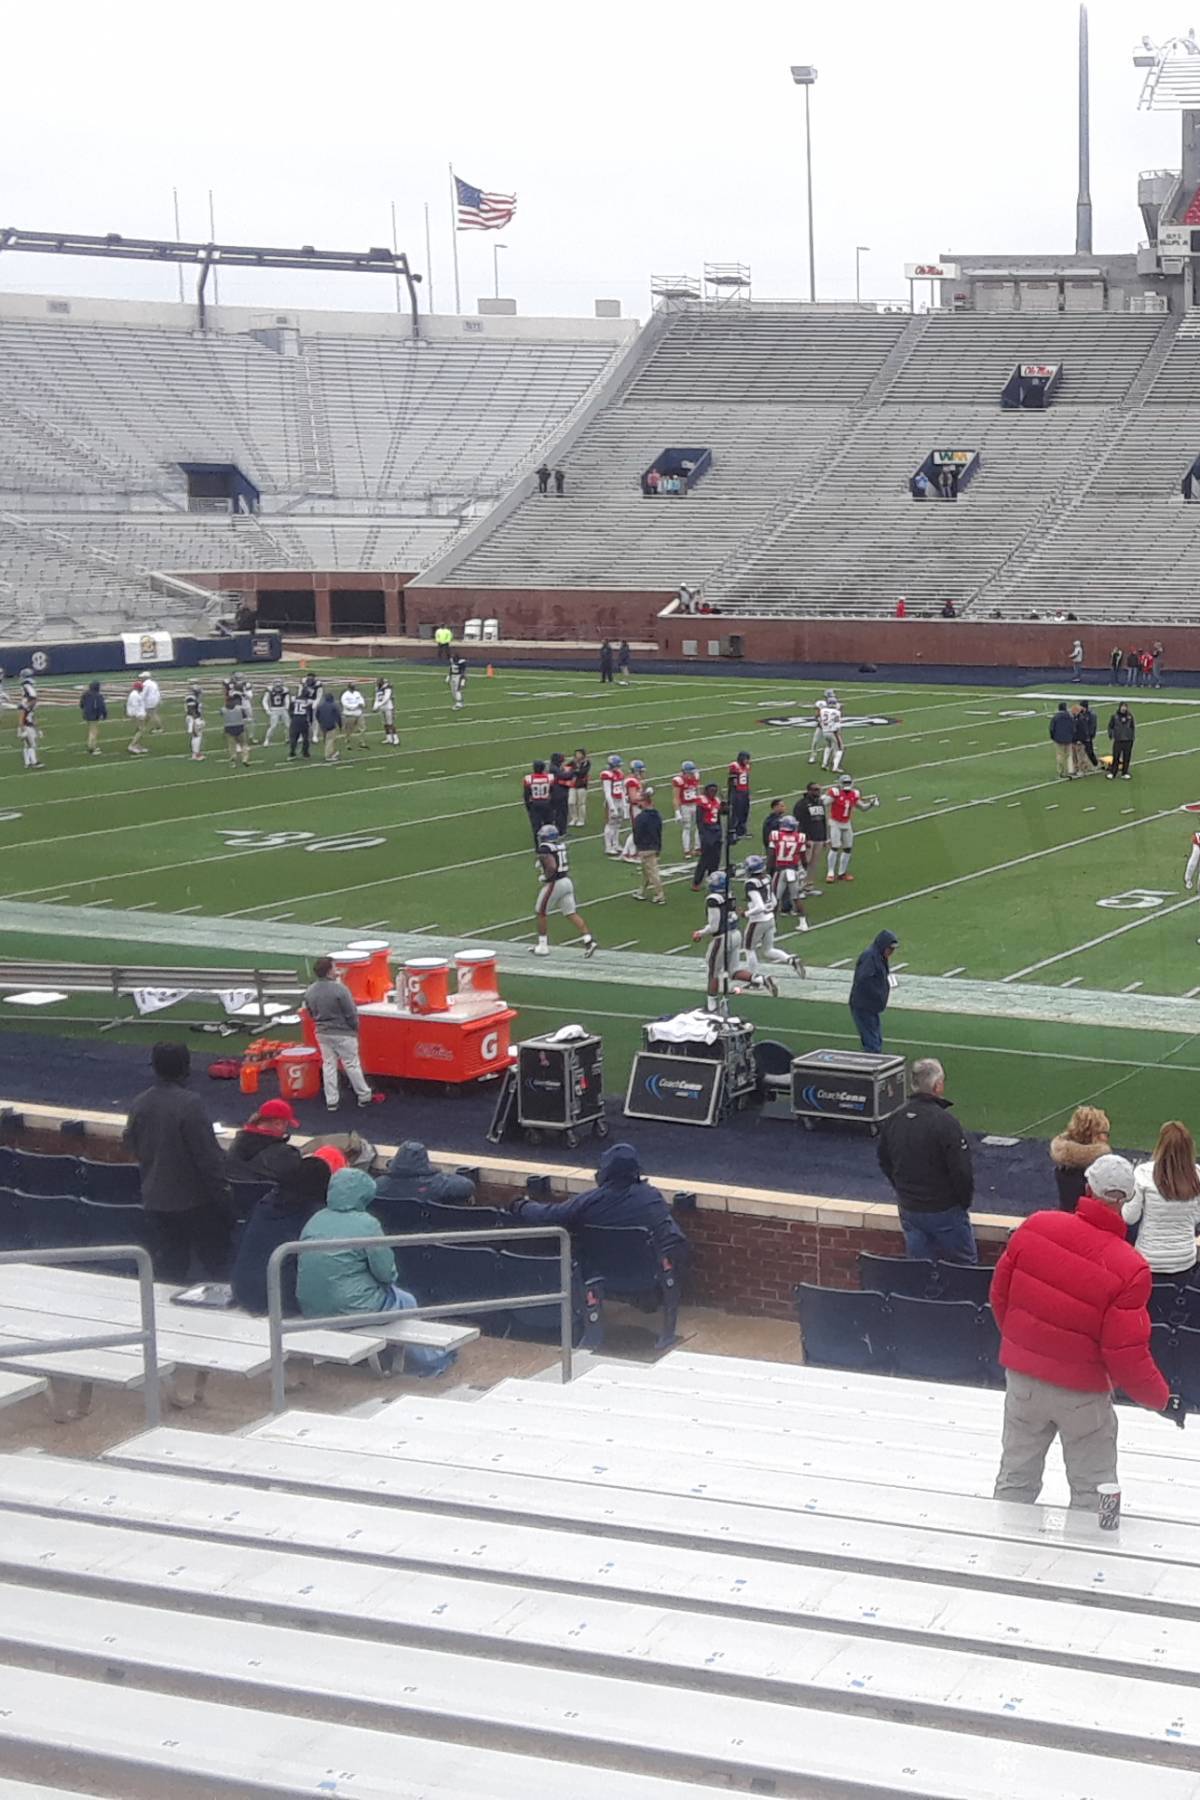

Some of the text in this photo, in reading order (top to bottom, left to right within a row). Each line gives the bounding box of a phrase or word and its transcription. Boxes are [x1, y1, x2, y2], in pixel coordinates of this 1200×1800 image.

[777, 841, 798, 861] 17
[481, 1031, 499, 1060] G
[817, 1088, 867, 1103] CoachComm
